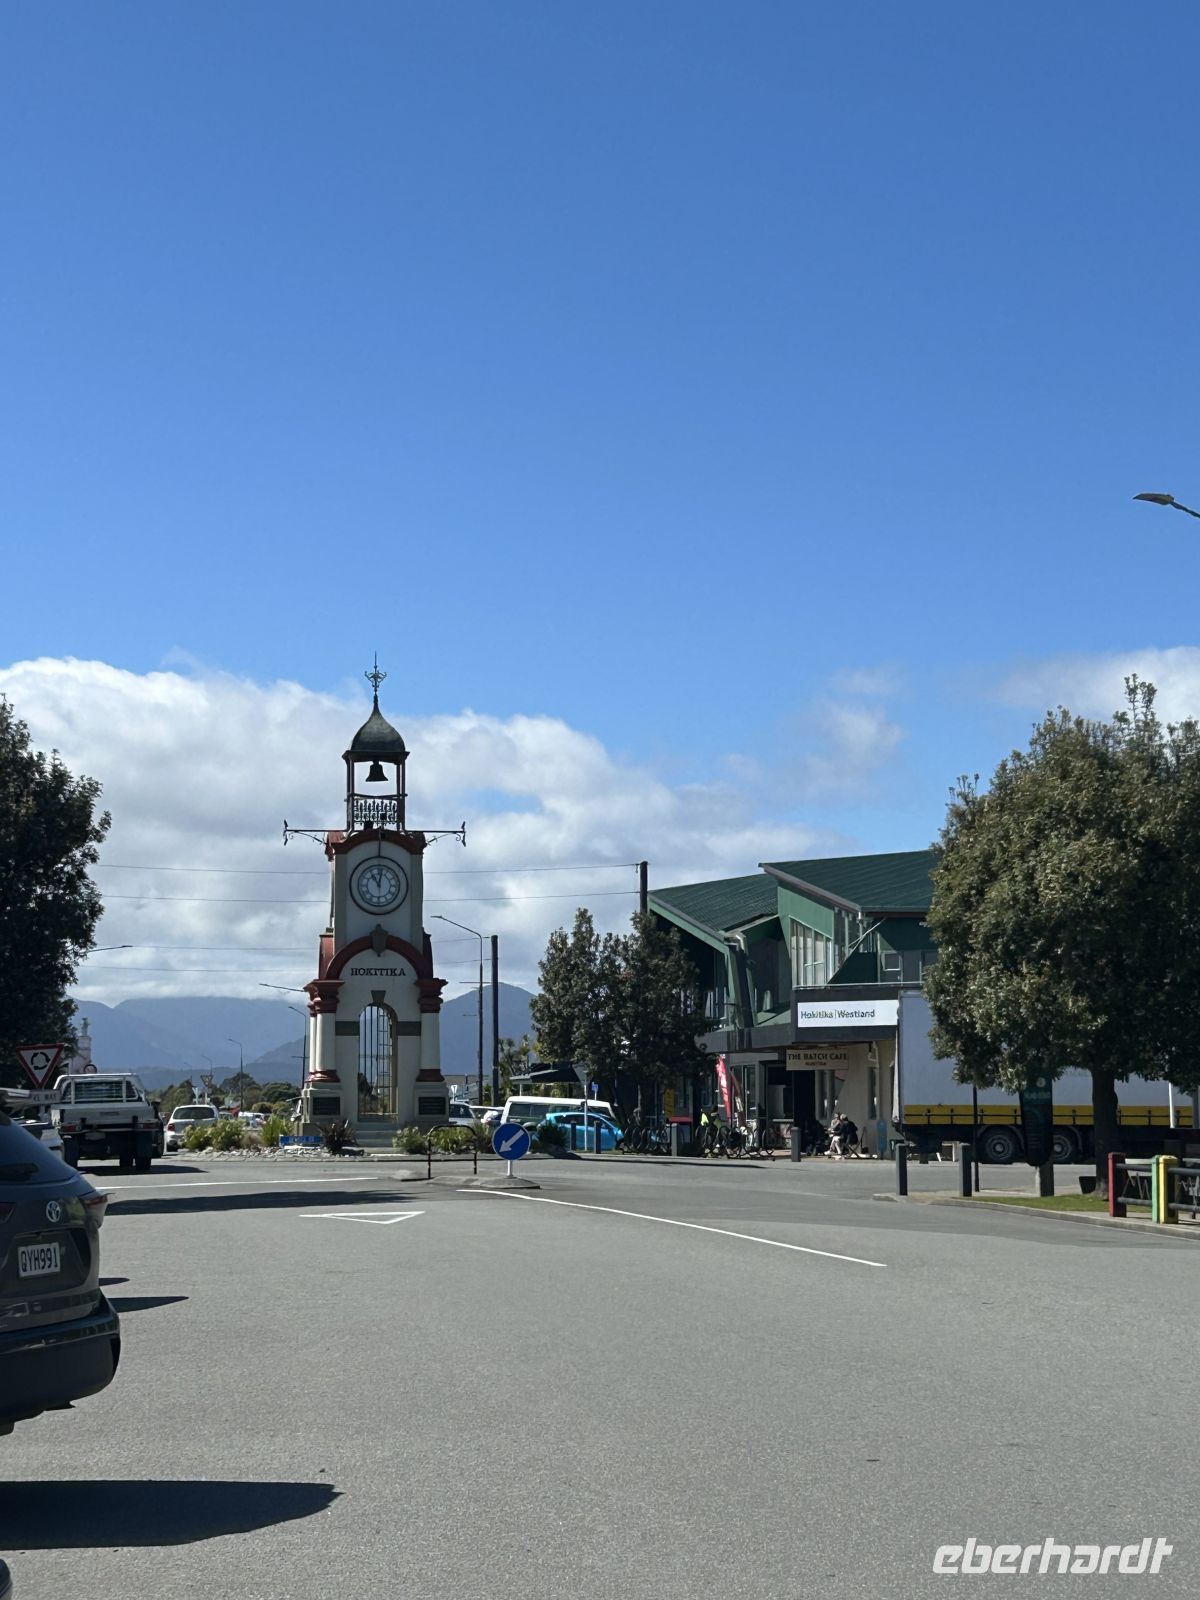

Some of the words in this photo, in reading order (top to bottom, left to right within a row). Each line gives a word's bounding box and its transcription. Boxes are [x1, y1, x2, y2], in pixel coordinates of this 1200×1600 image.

[351, 967, 406, 977] HOKITIKA
[801, 1010, 834, 1020] Hokitika
[837, 1009, 875, 1019] Westland
[20, 1247, 59, 1273] QYH991
